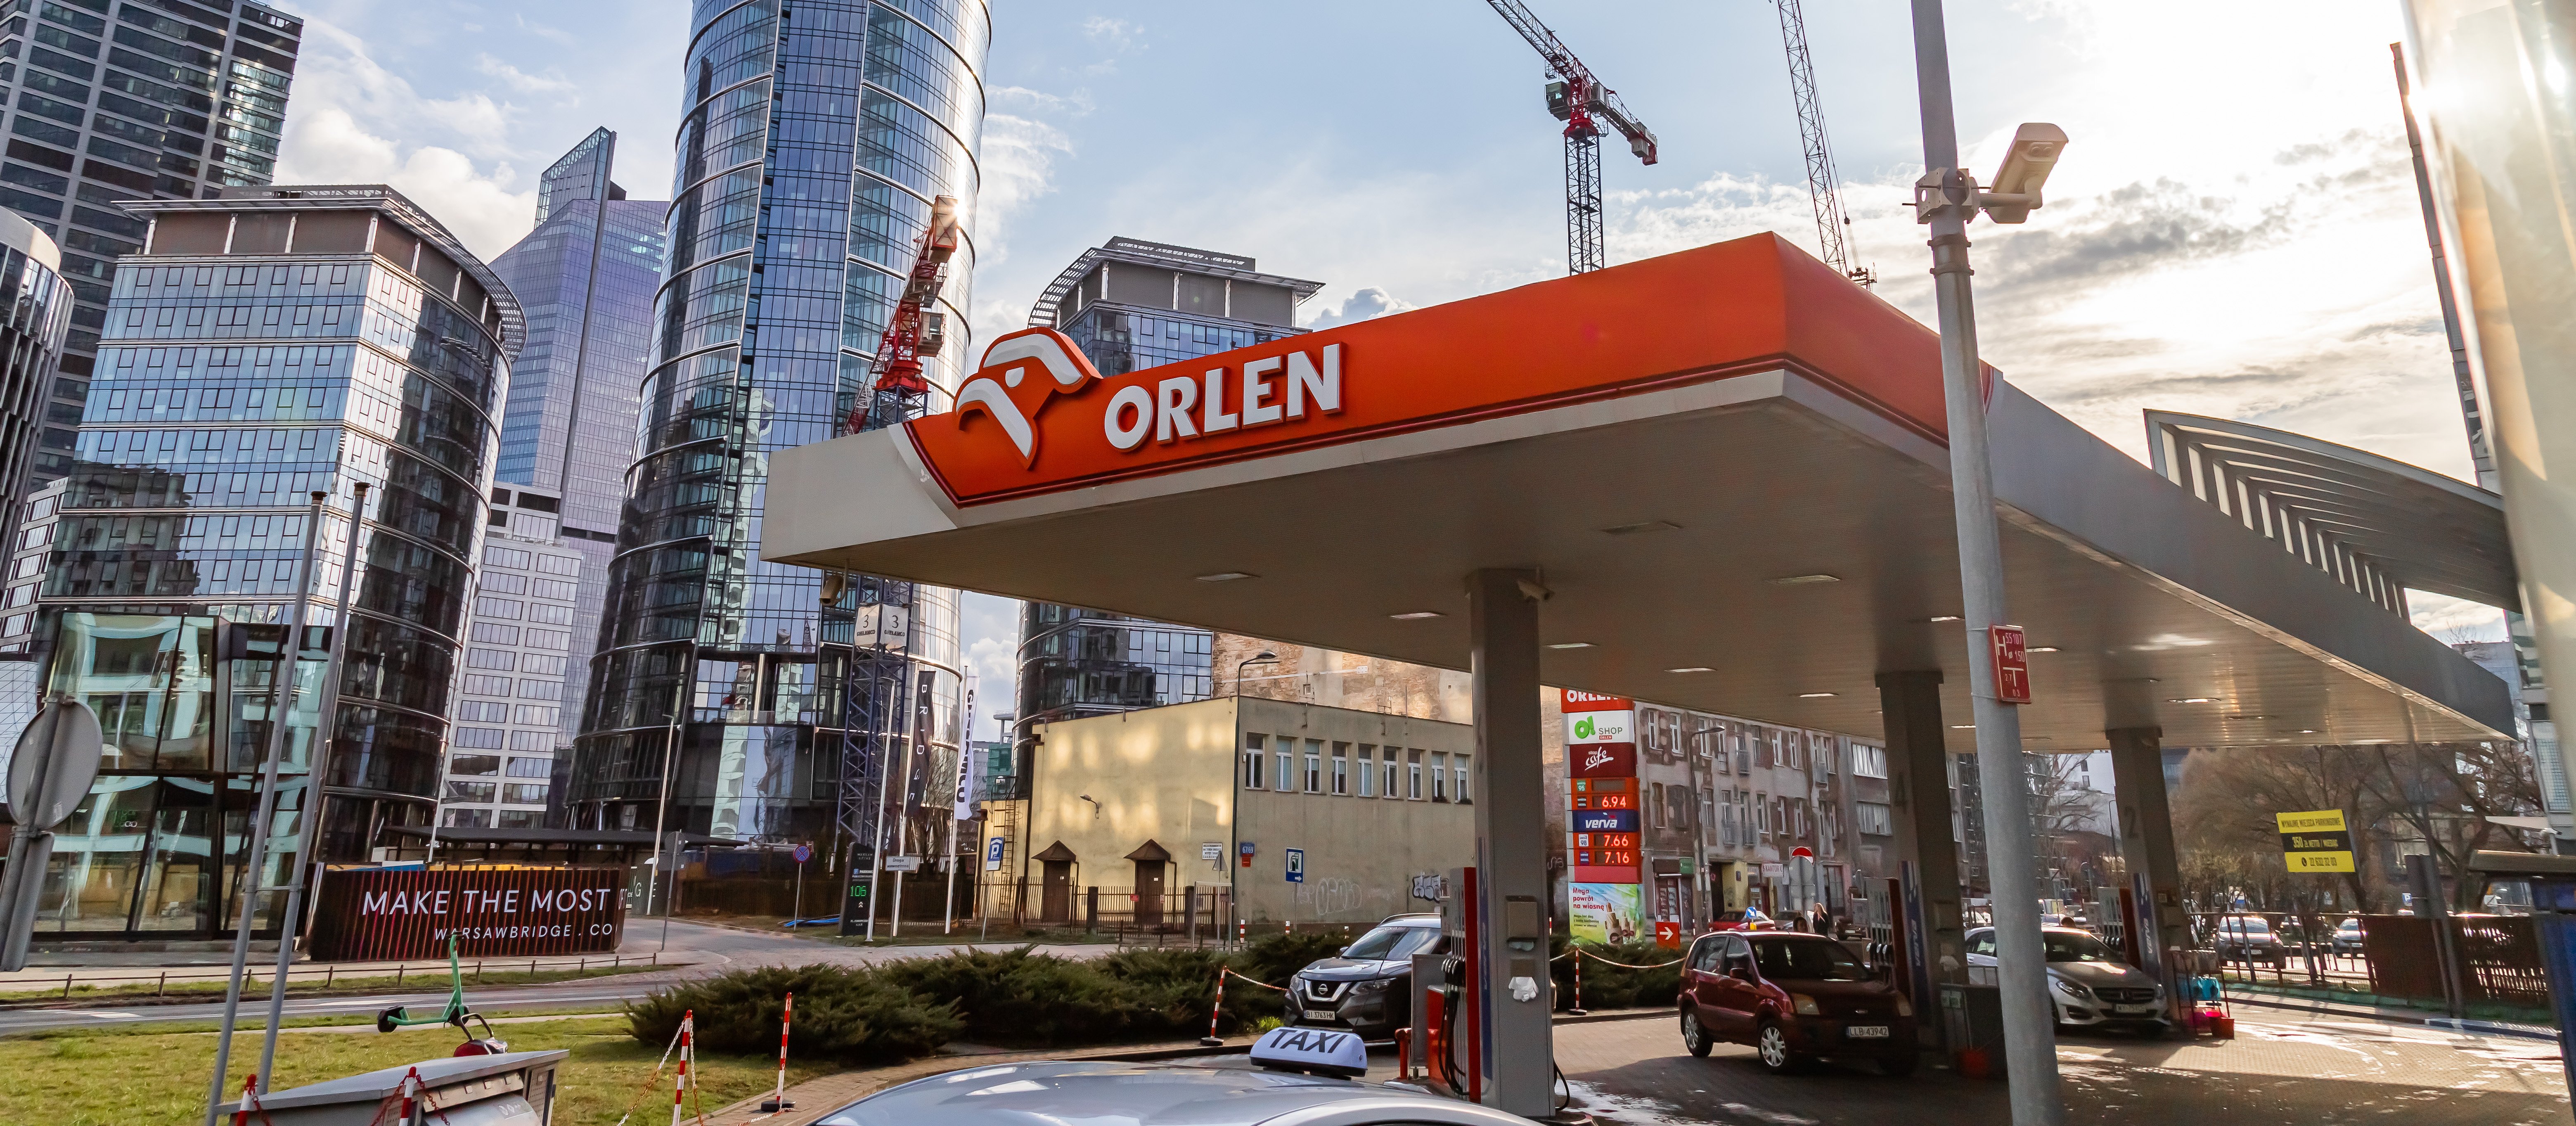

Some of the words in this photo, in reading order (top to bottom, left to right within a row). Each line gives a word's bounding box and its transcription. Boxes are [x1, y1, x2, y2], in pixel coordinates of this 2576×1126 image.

[1104, 343, 1341, 450] ORLEN
[863, 614, 869, 628] 3
[892, 615, 899, 628] 3
[1567, 690, 1618, 703] ORL
[1585, 746, 1608, 768] cafe
[1601, 796, 1627, 808] 6.94
[1585, 819, 1617, 828] verva
[1603, 834, 1629, 847] 7.66
[990, 844, 999, 860] P
[1604, 851, 1630, 864] 7.16
[1573, 887, 1590, 895] Mega
[362, 891, 451, 915] MAKE
[463, 889, 519, 913] THE
[531, 889, 611, 913] MOST
[1582, 903, 1605, 911] wiosnę
[1269, 1028, 1348, 1053] TAXI
